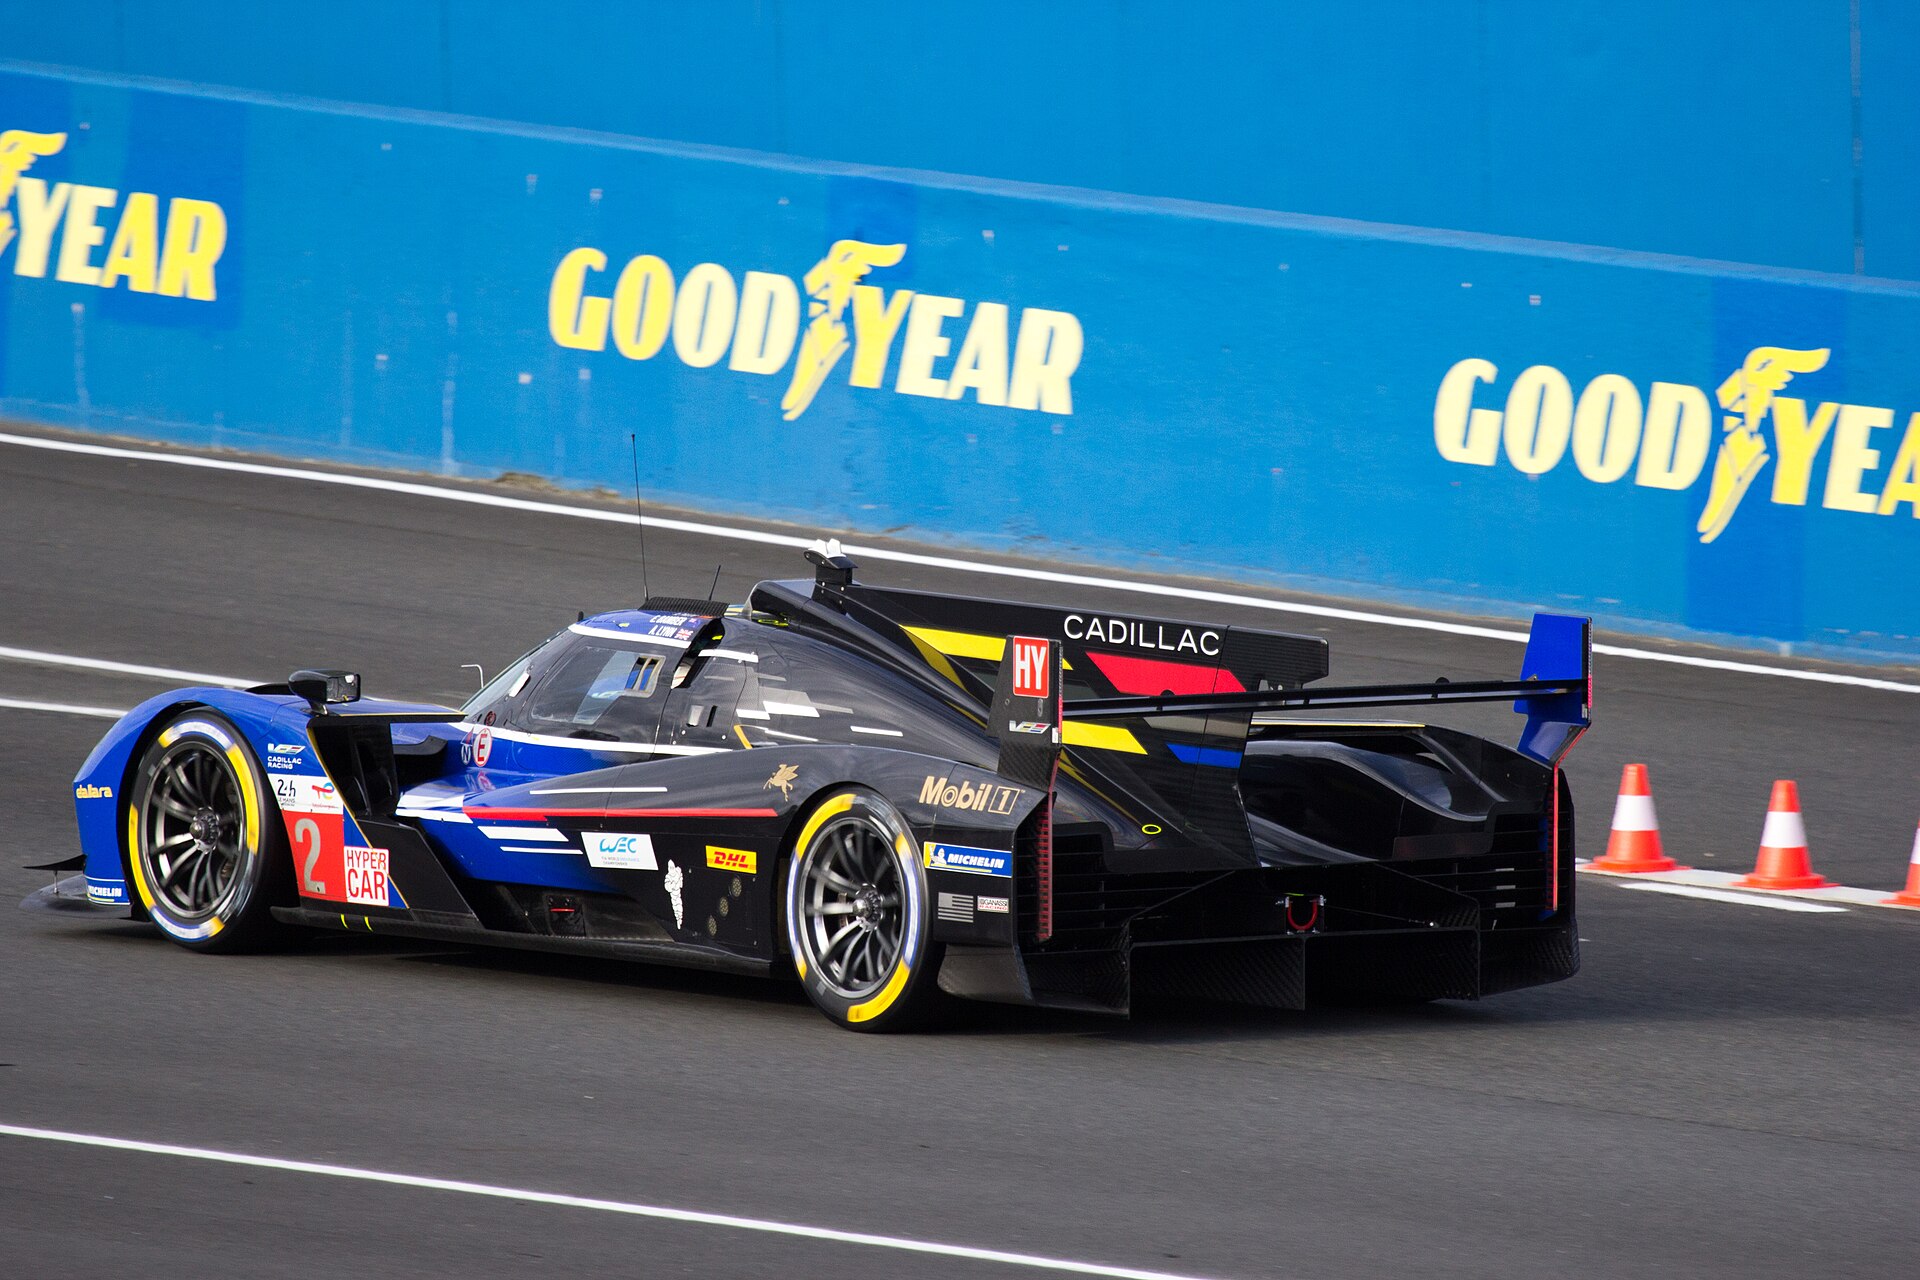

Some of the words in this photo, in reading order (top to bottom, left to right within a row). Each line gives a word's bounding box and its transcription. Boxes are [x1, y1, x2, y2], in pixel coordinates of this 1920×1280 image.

[1064, 615, 1219, 656] CADILLAC
[1015, 644, 1046, 690] HY
[478, 733, 487, 761] E
[267, 756, 302, 764] CADILLAC
[76, 784, 112, 798] dallara
[919, 776, 993, 811] Mobil
[295, 818, 326, 894] 2
[600, 837, 637, 853] WEC
[346, 850, 387, 870] HYPER
[714, 851, 748, 868] DHL
[947, 853, 1005, 869] MICHELIN
[347, 868, 386, 900] CAR
